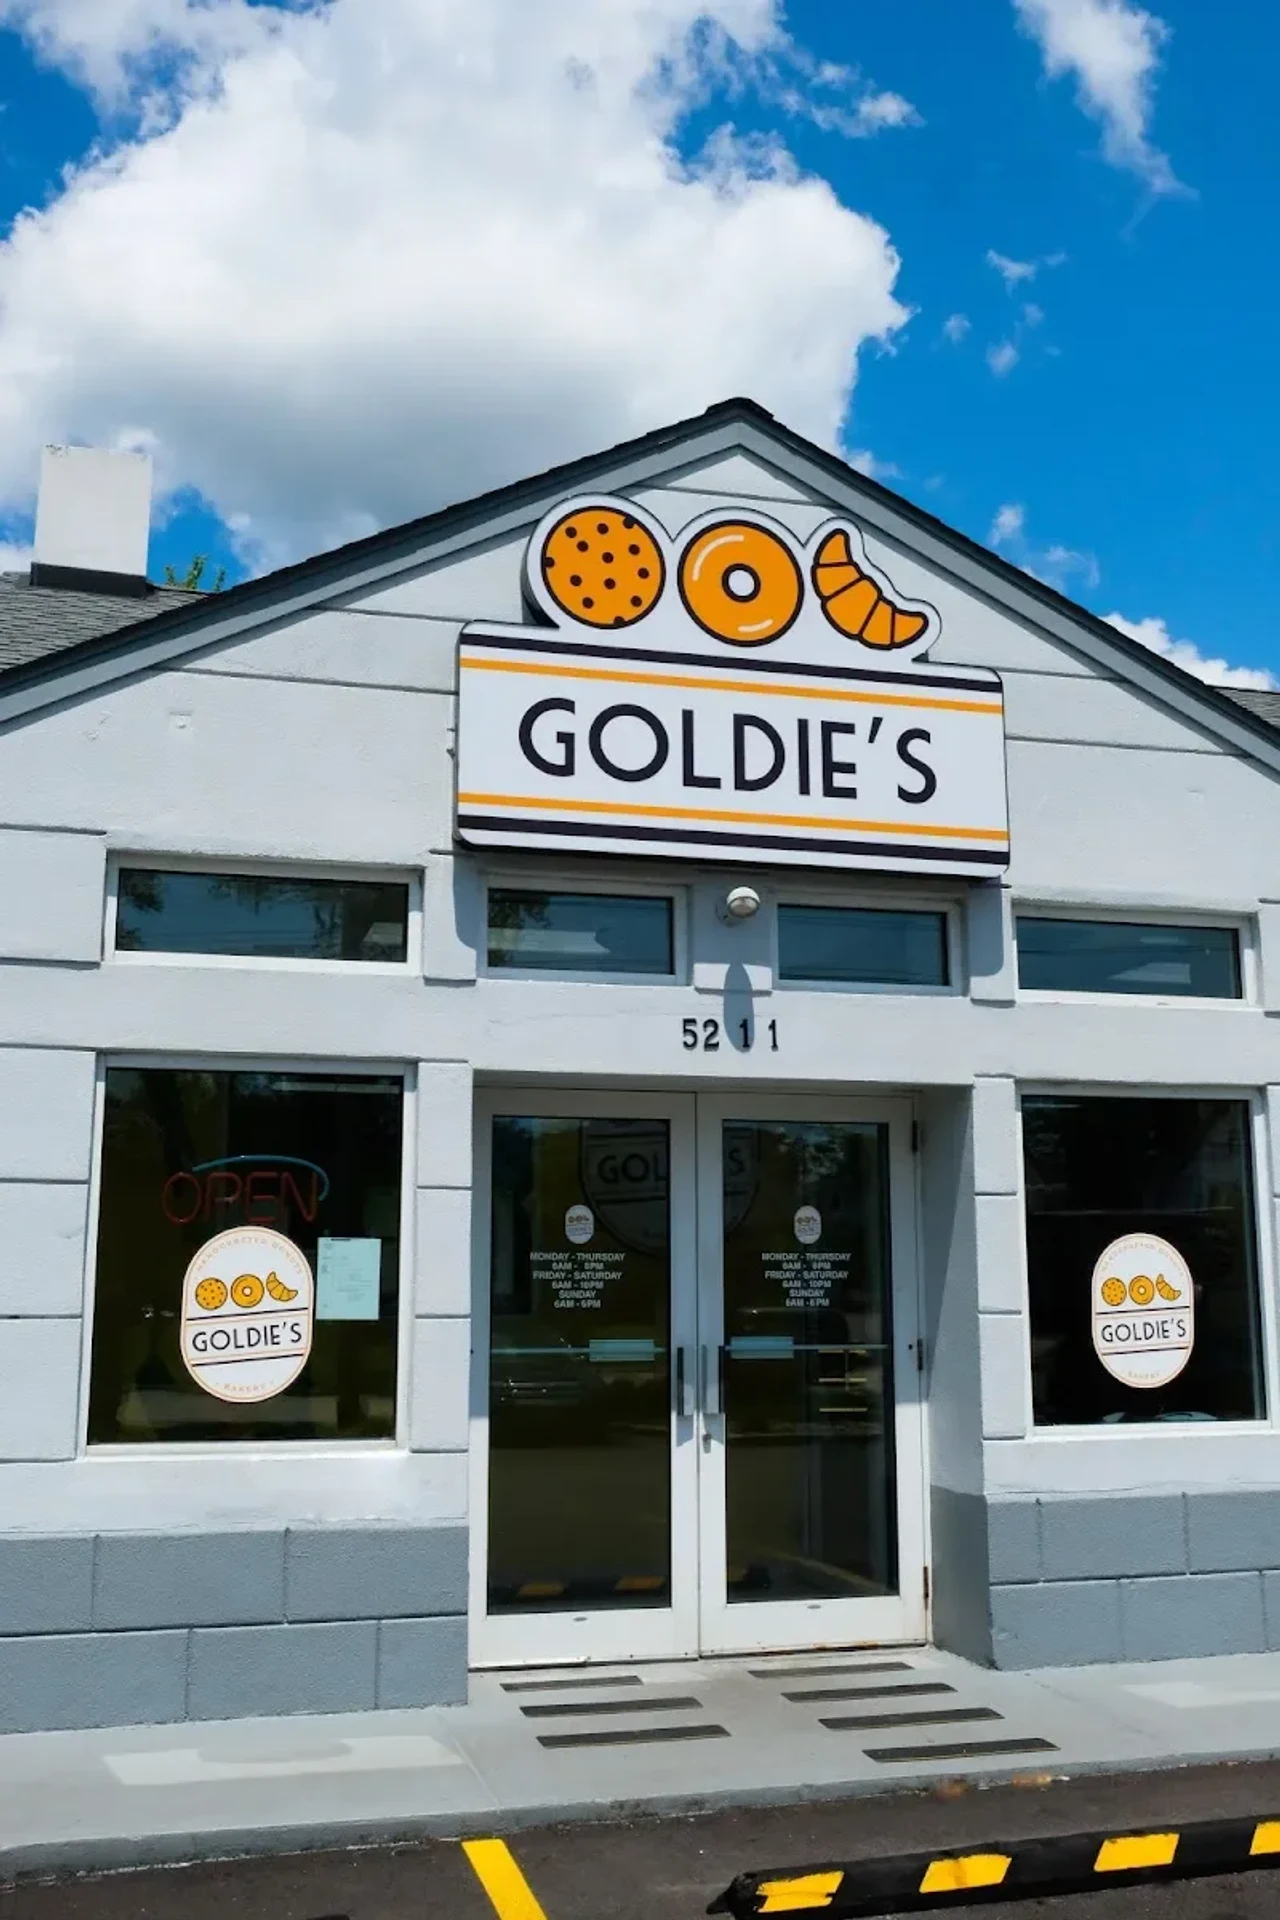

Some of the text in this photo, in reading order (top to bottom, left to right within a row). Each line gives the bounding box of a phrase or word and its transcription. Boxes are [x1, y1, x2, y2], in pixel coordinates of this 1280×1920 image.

[518, 697, 937, 805] GOLDIE'S
[681, 1018, 779, 1053] 5211
[162, 1171, 318, 1224] OPEN
[529, 1252, 570, 1261] MONDAY
[576, 1252, 627, 1261] THURSDAY
[761, 1252, 799, 1261] MONDAY
[805, 1252, 852, 1261] THURSDAY
[532, 1271, 567, 1280] FRIDAY
[573, 1271, 623, 1280] SATURDAY
[764, 1270, 797, 1279] FRIDAY
[802, 1270, 849, 1279] SATURDAY
[579, 1280, 604, 1289] 10PM
[809, 1280, 832, 1288] 10PM
[558, 1290, 597, 1299] SUNDAY
[789, 1289, 825, 1298] SUNDAY
[553, 1299, 575, 1308] 6AM
[1101, 1318, 1186, 1342] GOLDIE'S
[192, 1322, 302, 1352] GOLDIE'S
